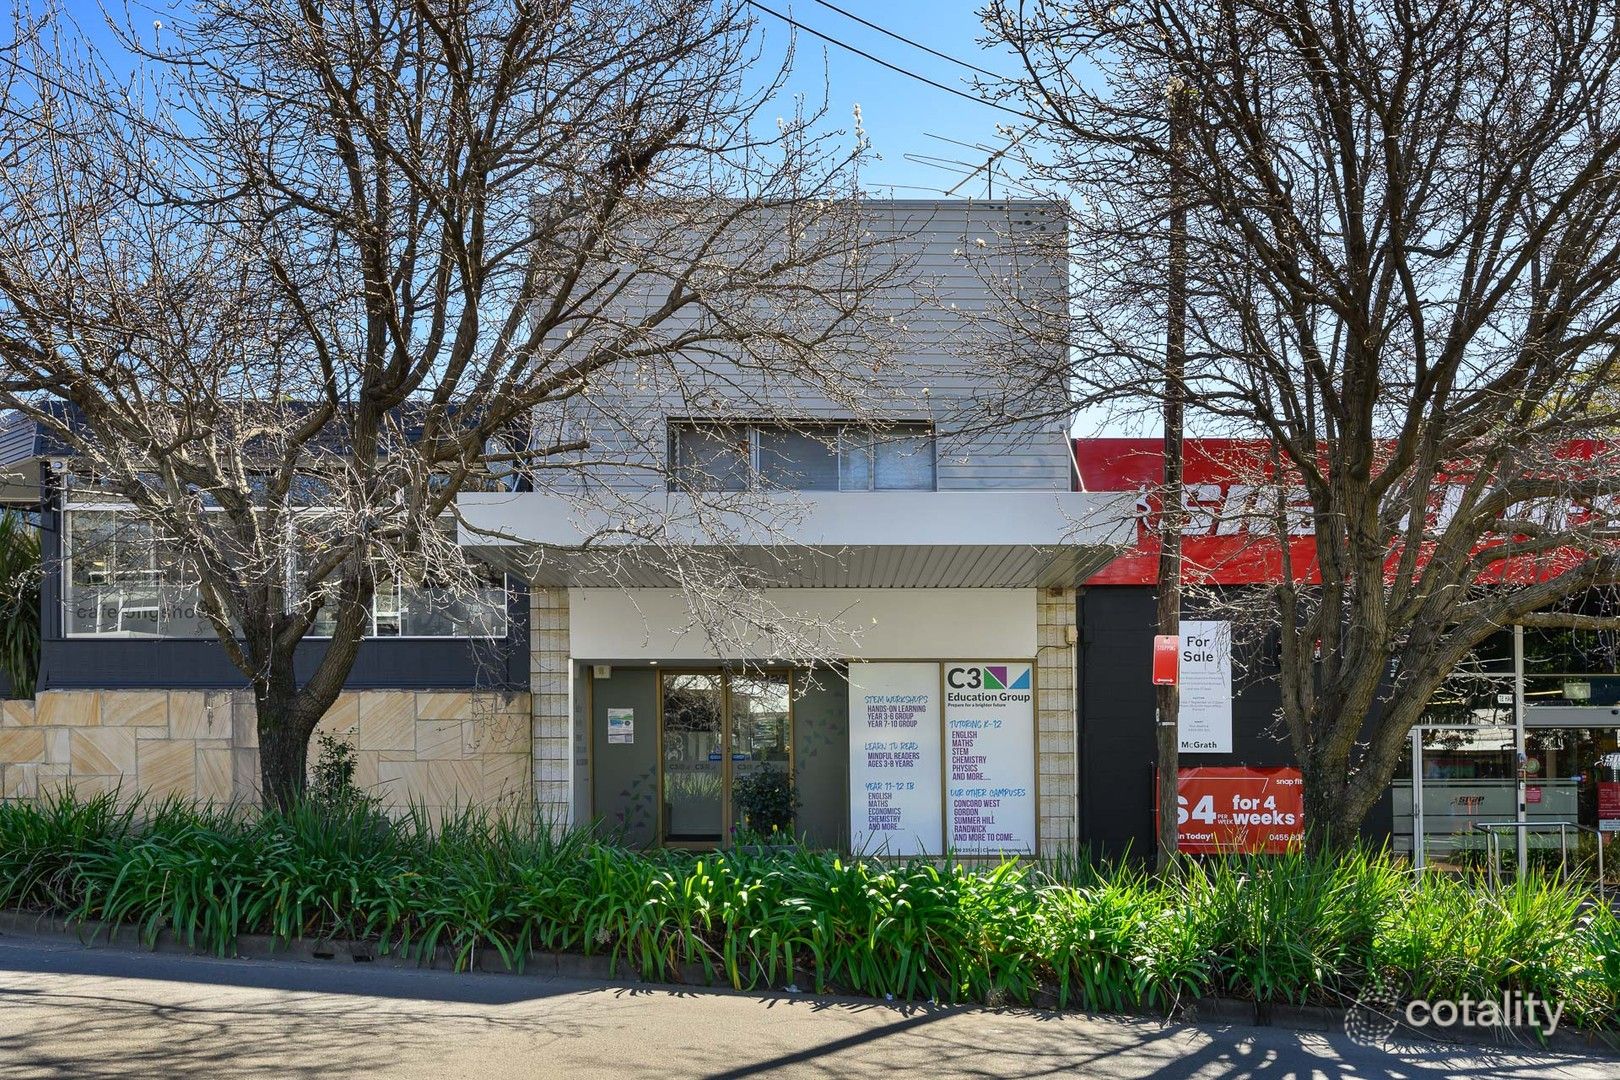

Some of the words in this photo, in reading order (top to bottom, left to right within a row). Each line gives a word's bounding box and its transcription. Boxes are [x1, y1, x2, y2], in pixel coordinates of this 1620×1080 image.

[1187, 636, 1210, 647] For
[1183, 651, 1214, 663] Sale
[947, 667, 982, 689] C3
[864, 695, 884, 704] STEM
[947, 692, 998, 702] Education
[999, 692, 1031, 703] Group
[867, 705, 897, 713] HANDS-ON
[898, 705, 926, 713] LEARNING
[867, 720, 883, 728] YEAR
[883, 720, 898, 728] 7-10
[898, 720, 918, 728] GROUP
[949, 720, 982, 729] TUTORING
[983, 720, 1002, 728] K-12
[951, 731, 977, 739] ENGLISH
[864, 743, 887, 751] LEARN
[900, 743, 919, 751] READ
[951, 740, 974, 748] MATHS
[1181, 741, 1217, 749] McGrath
[867, 752, 893, 760] MINDFUL
[893, 752, 920, 760] READERS
[951, 748, 969, 756] STEM
[867, 760, 883, 768] AGES
[883, 760, 894, 768] 3-8
[895, 760, 914, 768] YEARS
[951, 756, 987, 764] CHEMISTRY
[952, 765, 978, 773] PHYSICS
[865, 782, 883, 791] YEAR
[885, 782, 904, 790] 11-12
[950, 789, 964, 797] OUR
[965, 788, 988, 798] OTHER
[989, 788, 1026, 797] CAMPUSES
[868, 800, 889, 808] MATHS
[953, 800, 983, 808] CONCORD
[983, 800, 1001, 808] WEST
[1232, 795, 1260, 810] for
[1263, 795, 1277, 810] 4
[868, 808, 902, 816] ECONOMICS
[953, 808, 979, 816] GORDON
[954, 816, 981, 824] SUMMER
[981, 816, 996, 824] HILL
[1232, 809, 1296, 826] weeks
[868, 823, 881, 831] AND
[954, 825, 987, 833] RANDWICK
[954, 833, 969, 841] AND
[969, 833, 986, 841] MORE
[987, 833, 995, 841] TO
[1186, 833, 1214, 842] Today!
